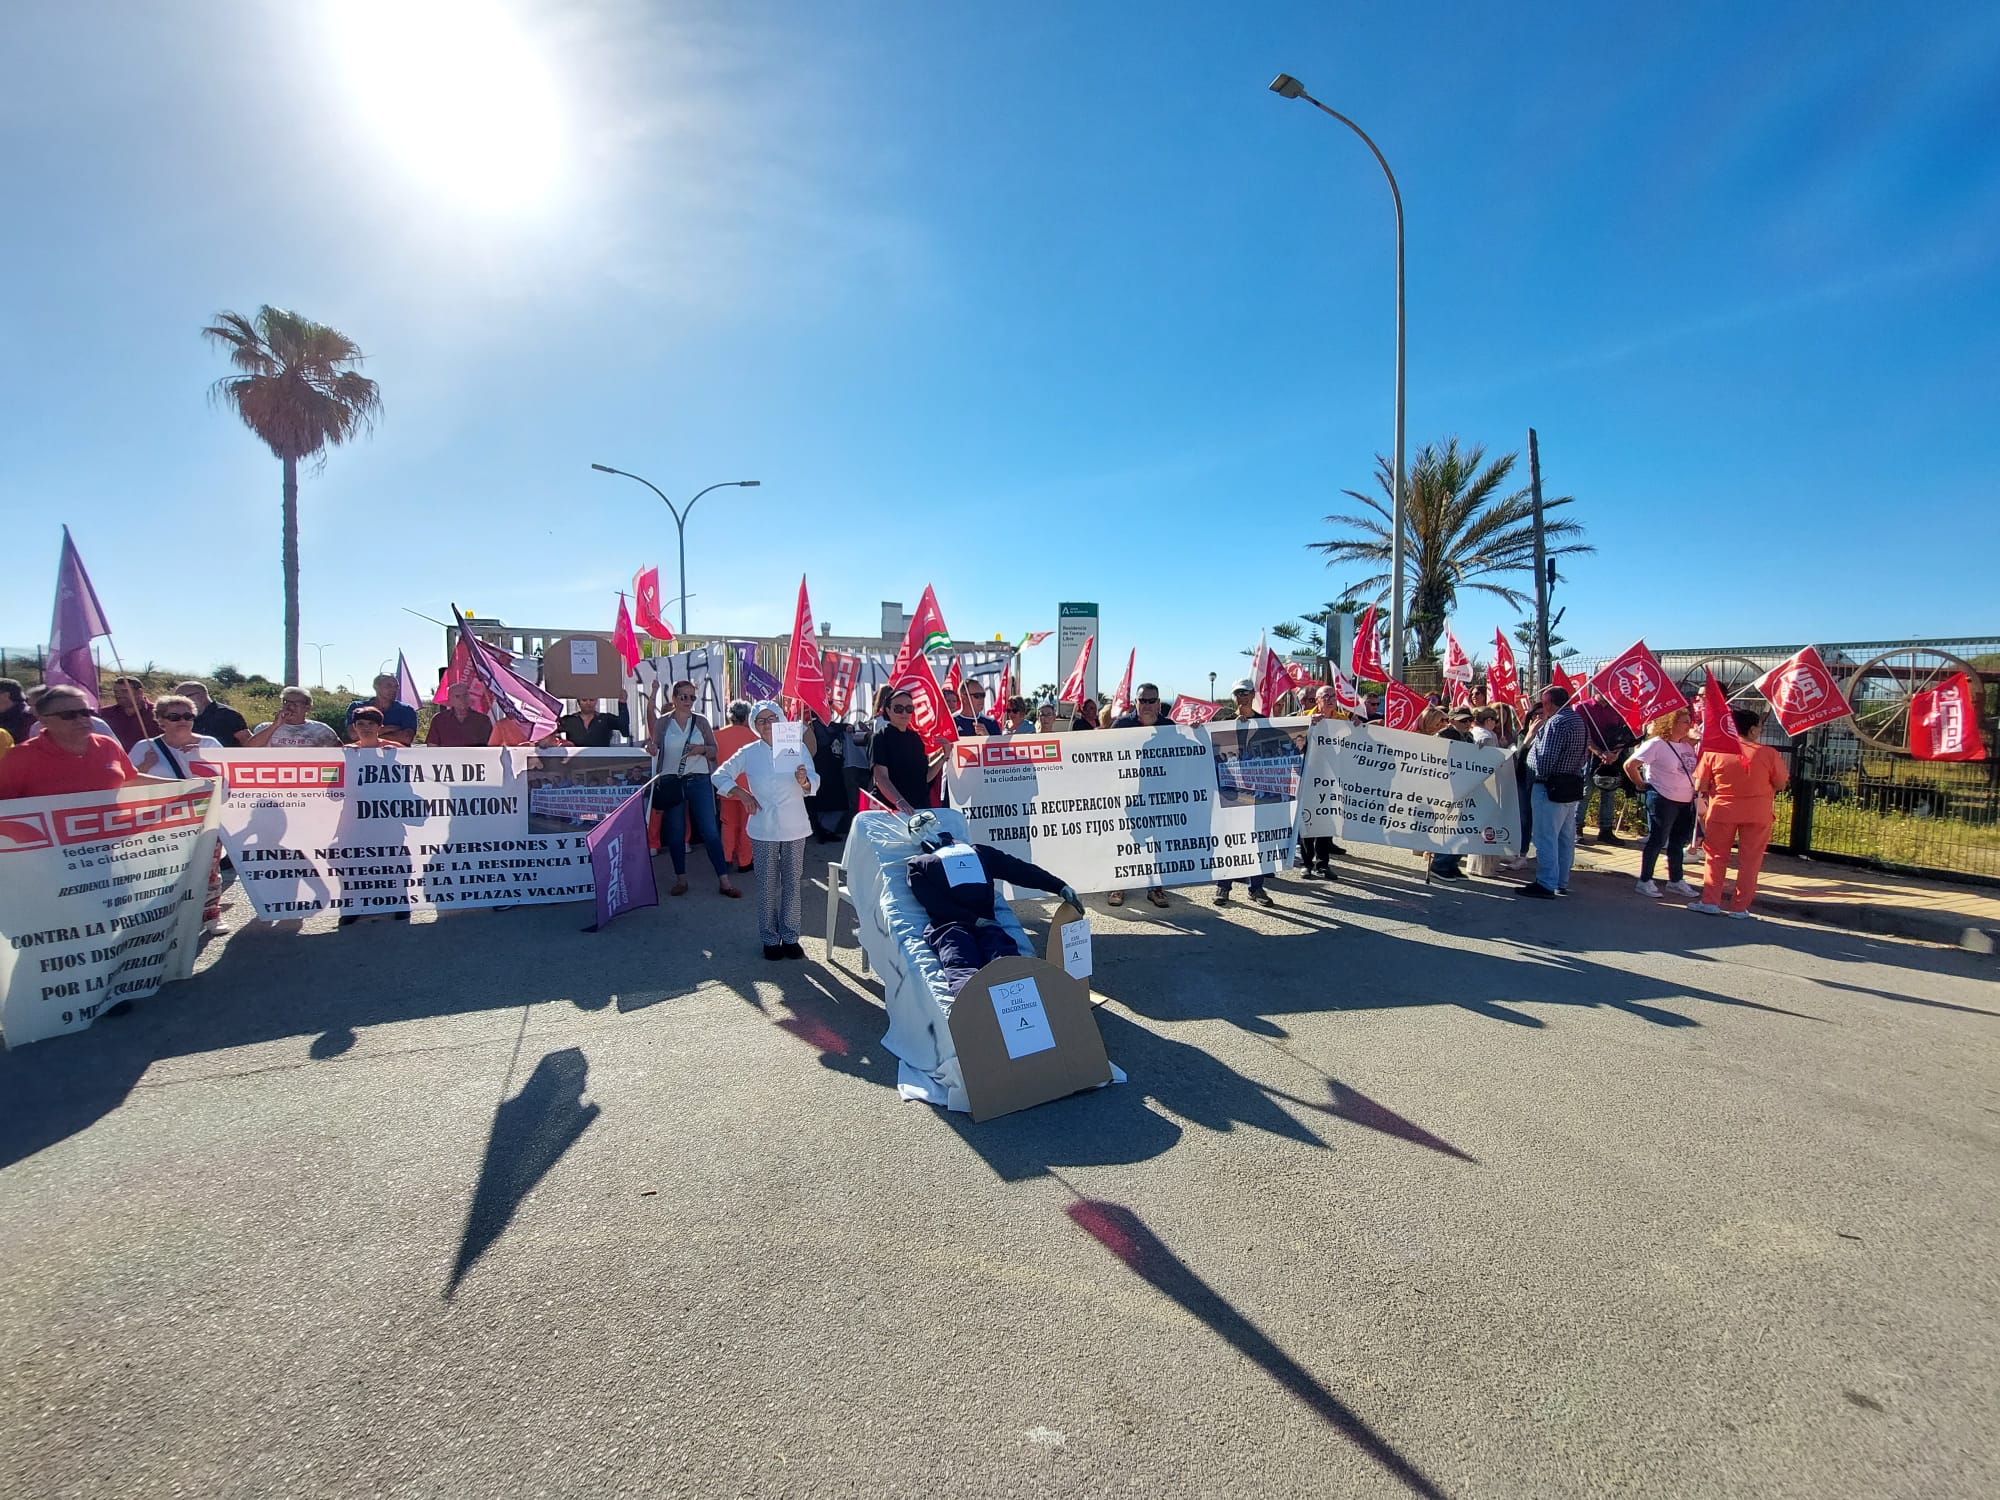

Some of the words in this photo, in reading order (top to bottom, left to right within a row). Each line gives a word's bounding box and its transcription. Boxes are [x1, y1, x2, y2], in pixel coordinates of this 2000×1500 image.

[1796, 667, 1824, 700] UGT
[987, 745, 1044, 762] CCOO
[1071, 751, 1114, 763] CONTRA
[1117, 750, 1132, 761] LA
[1135, 745, 1207, 760] PRECARIEDAD
[1317, 736, 1373, 753] Residencia
[1376, 744, 1418, 762] Tiempo
[1420, 752, 1448, 766] Libre
[1450, 758, 1462, 769] La
[234, 767, 318, 784] CCOO
[357, 764, 425, 786] ¡BASTA
[432, 763, 455, 783] YA
[462, 763, 486, 782] DE
[1118, 766, 1167, 779] LABORAL
[286, 791, 298, 799] de
[301, 791, 346, 799] servicios
[1313, 777, 1335, 787] Por
[1344, 782, 1403, 800] cobertura
[1407, 792, 1423, 804] de
[1465, 798, 1477, 808] YA
[237, 801, 246, 809] la
[357, 797, 518, 820] DISCRIMINACION!
[962, 804, 1018, 820] EXIGIMOS
[1022, 802, 1037, 816] LA
[1041, 796, 1121, 814] RECUPERACION
[1125, 793, 1146, 808] DEL
[1148, 790, 1189, 806] TIEMPO
[1193, 789, 1208, 802] DE
[1319, 793, 1326, 804] y
[1388, 803, 1404, 814] de
[1408, 806, 1446, 822] tiempo
[1447, 814, 1459, 822] en
[1459, 812, 1475, 821] los
[64, 801, 192, 837] CCOO
[989, 825, 1038, 842] TRABAJO
[1043, 824, 1057, 838] DE
[1062, 821, 1082, 836] LOS
[1086, 819, 1115, 836] FIJOS
[1119, 813, 1187, 830] DISCONTINUO
[1361, 813, 1376, 824] de
[1379, 816, 1406, 829] fijos
[1410, 821, 1481, 835] discontinuos.
[147, 834, 166, 844] de
[241, 850, 306, 862] LINEA
[315, 845, 412, 860] NECESITA
[420, 840, 548, 856] INVERSIONES
[556, 839, 568, 850] Y
[575, 837, 585, 848] E
[1117, 843, 1142, 857] POR
[1146, 840, 1162, 854] UN
[1165, 835, 1219, 852] TRABAJO
[1224, 832, 1247, 848] QUE
[67, 862, 77, 871] a
[81, 858, 94, 869] la
[111, 871, 142, 887] TIEMPO
[143, 866, 168, 881] LIBRE
[168, 864, 180, 876] LA
[248, 868, 321, 881] EFORMA
[327, 864, 416, 877] INTEGRAL
[423, 862, 445, 873] DE
[451, 861, 472, 871] LA
[478, 857, 572, 869] RESIDENCIA
[1115, 859, 1196, 878] ESTABILIDAD
[1200, 853, 1255, 870] LABORAL
[1257, 852, 1265, 864] Y
[343, 879, 397, 890] LIBRE
[403, 877, 427, 888] DE
[433, 876, 453, 886] LA
[459, 873, 506, 885] LINEA
[512, 872, 538, 882] YA!
[330, 898, 354, 909] DE
[360, 895, 418, 906] TODAS
[425, 892, 455, 903] LAS
[461, 888, 522, 900] PLAZAS
[528, 883, 595, 897] VACANTE
[11, 927, 81, 950] CONTRA
[85, 922, 106, 938] LA
[40, 951, 87, 973] FIJOS
[41, 981, 81, 1001] POR
[86, 976, 104, 993] LA
[62, 1011, 73, 1025] 9
